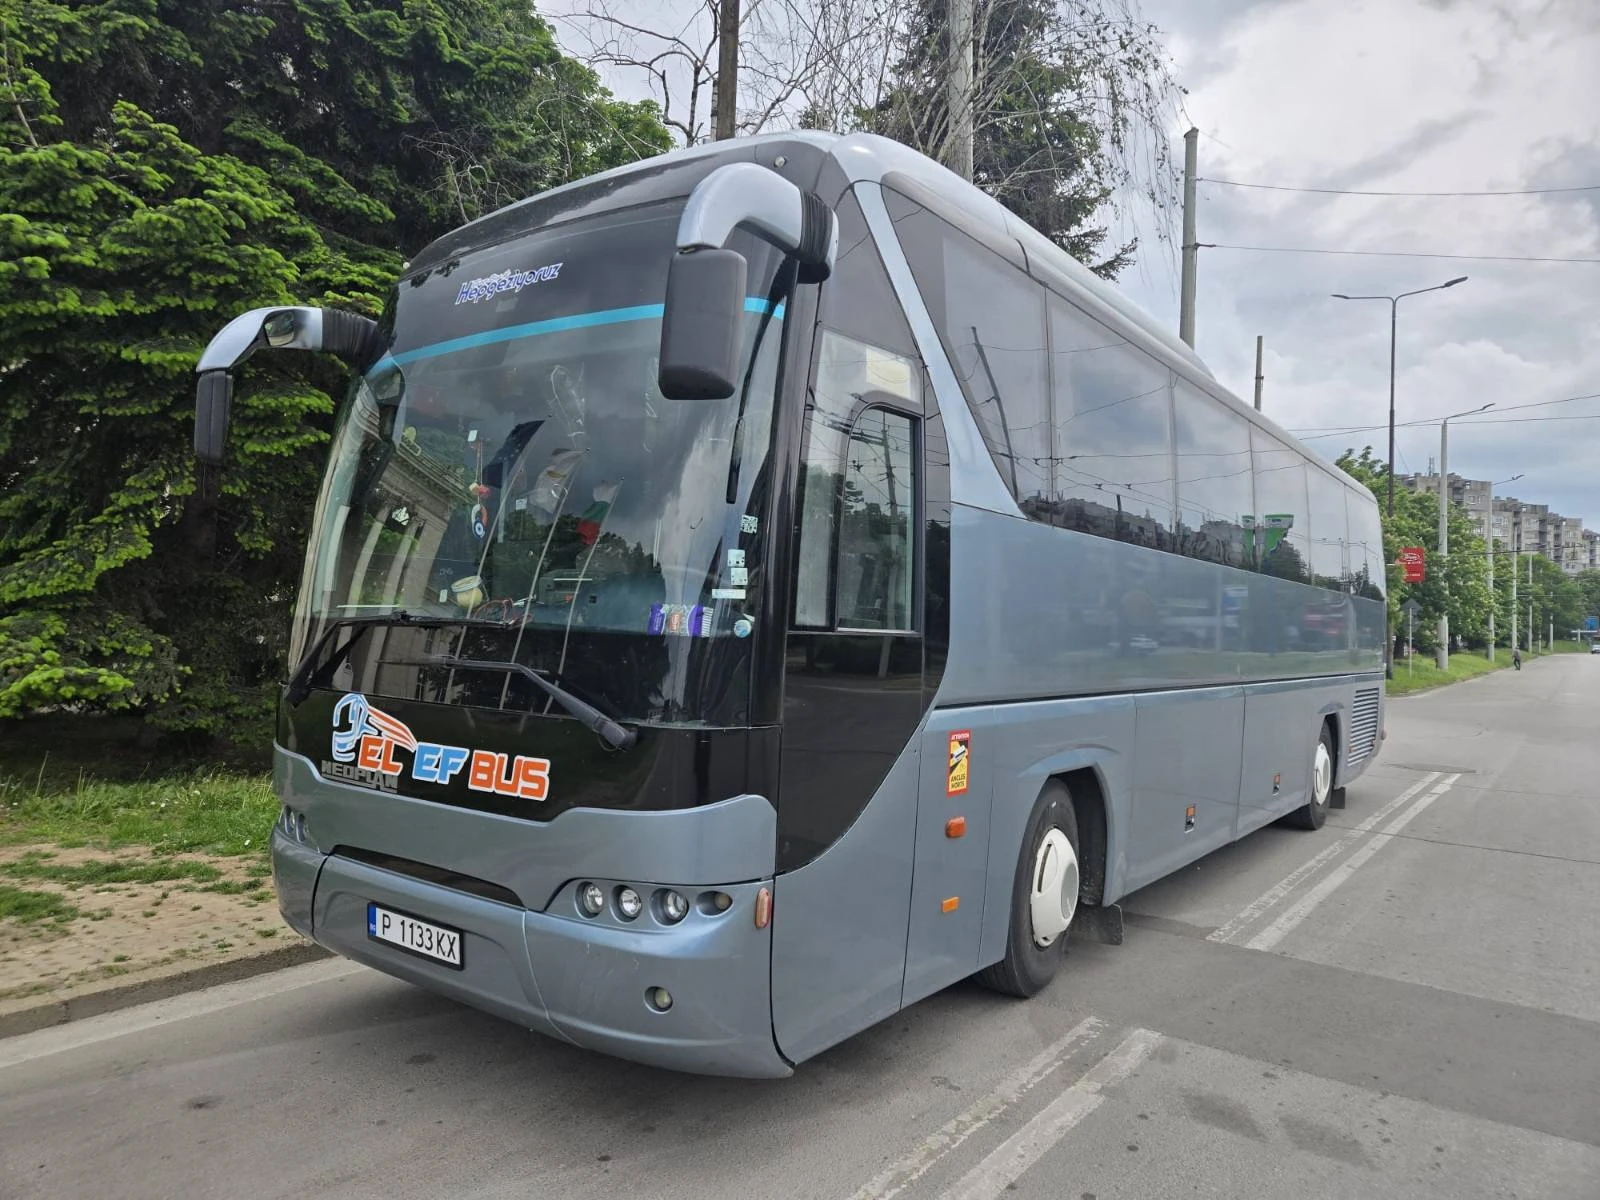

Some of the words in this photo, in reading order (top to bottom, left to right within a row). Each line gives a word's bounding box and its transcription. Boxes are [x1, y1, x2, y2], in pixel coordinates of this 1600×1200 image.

[321, 760, 398, 792] NEOPLAN
[358, 734, 403, 776] EL
[412, 742, 469, 784] EF
[468, 750, 550, 801] BUS
